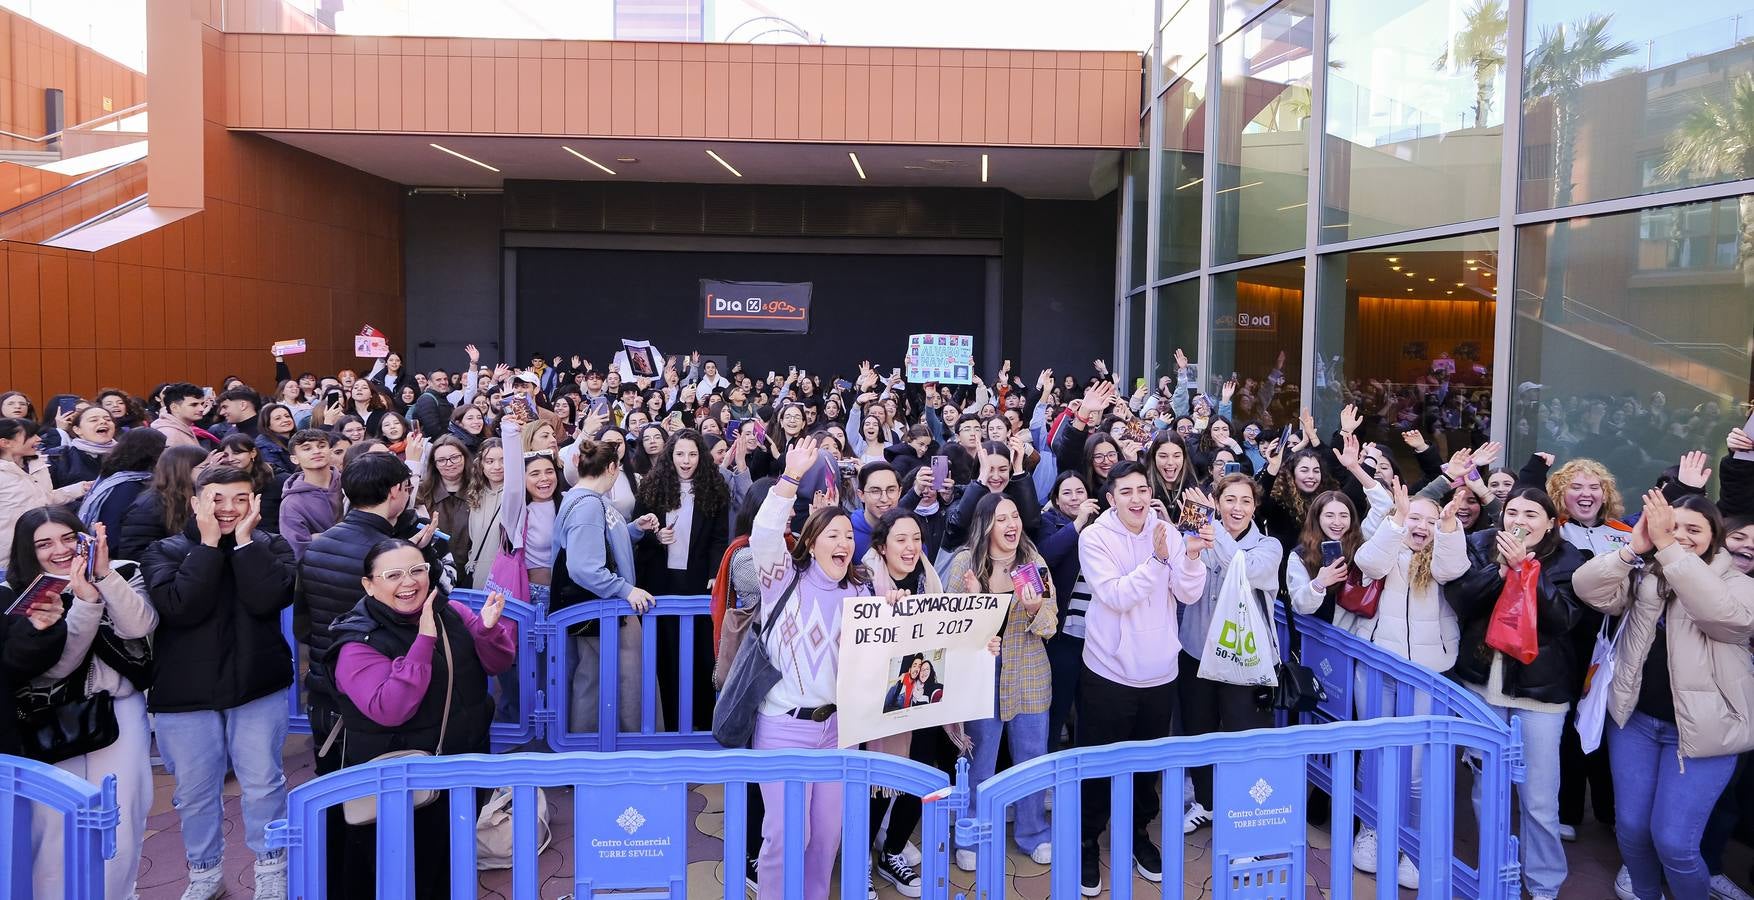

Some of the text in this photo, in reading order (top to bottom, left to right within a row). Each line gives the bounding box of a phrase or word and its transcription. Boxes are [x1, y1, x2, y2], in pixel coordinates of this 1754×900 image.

[853, 595, 998, 620] SOY ALEXMARQUISTA
[855, 619, 973, 645] DESDE EL 2017
[1227, 804, 1292, 818] Centro Comercial
[1234, 817, 1287, 829] TORRE SEVILLA
[591, 836, 671, 848] Centro Comercial
[598, 849, 664, 859] TORRE SEVILLA
